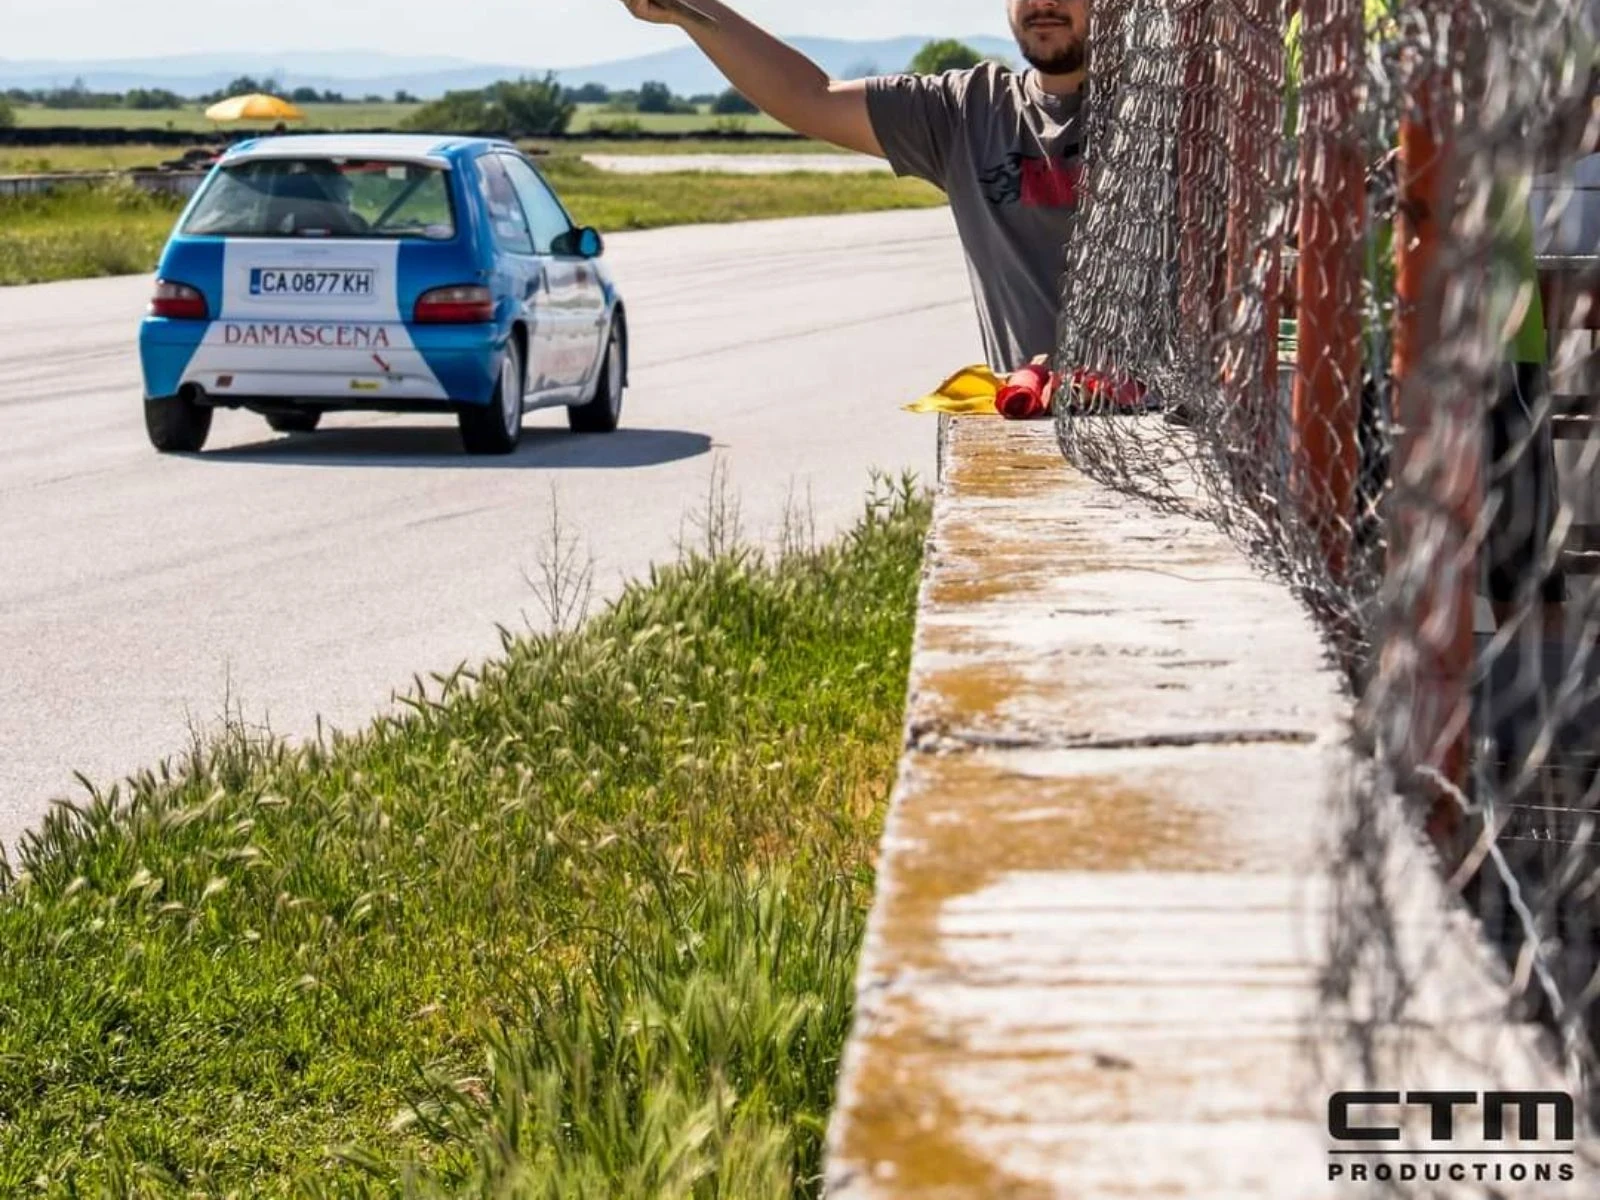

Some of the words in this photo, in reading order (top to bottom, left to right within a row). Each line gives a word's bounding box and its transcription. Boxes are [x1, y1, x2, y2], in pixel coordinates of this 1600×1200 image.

[263, 272, 288, 293] CA
[292, 273, 340, 294] 0877
[343, 273, 370, 293] KH
[224, 323, 390, 348] DAMASCENA
